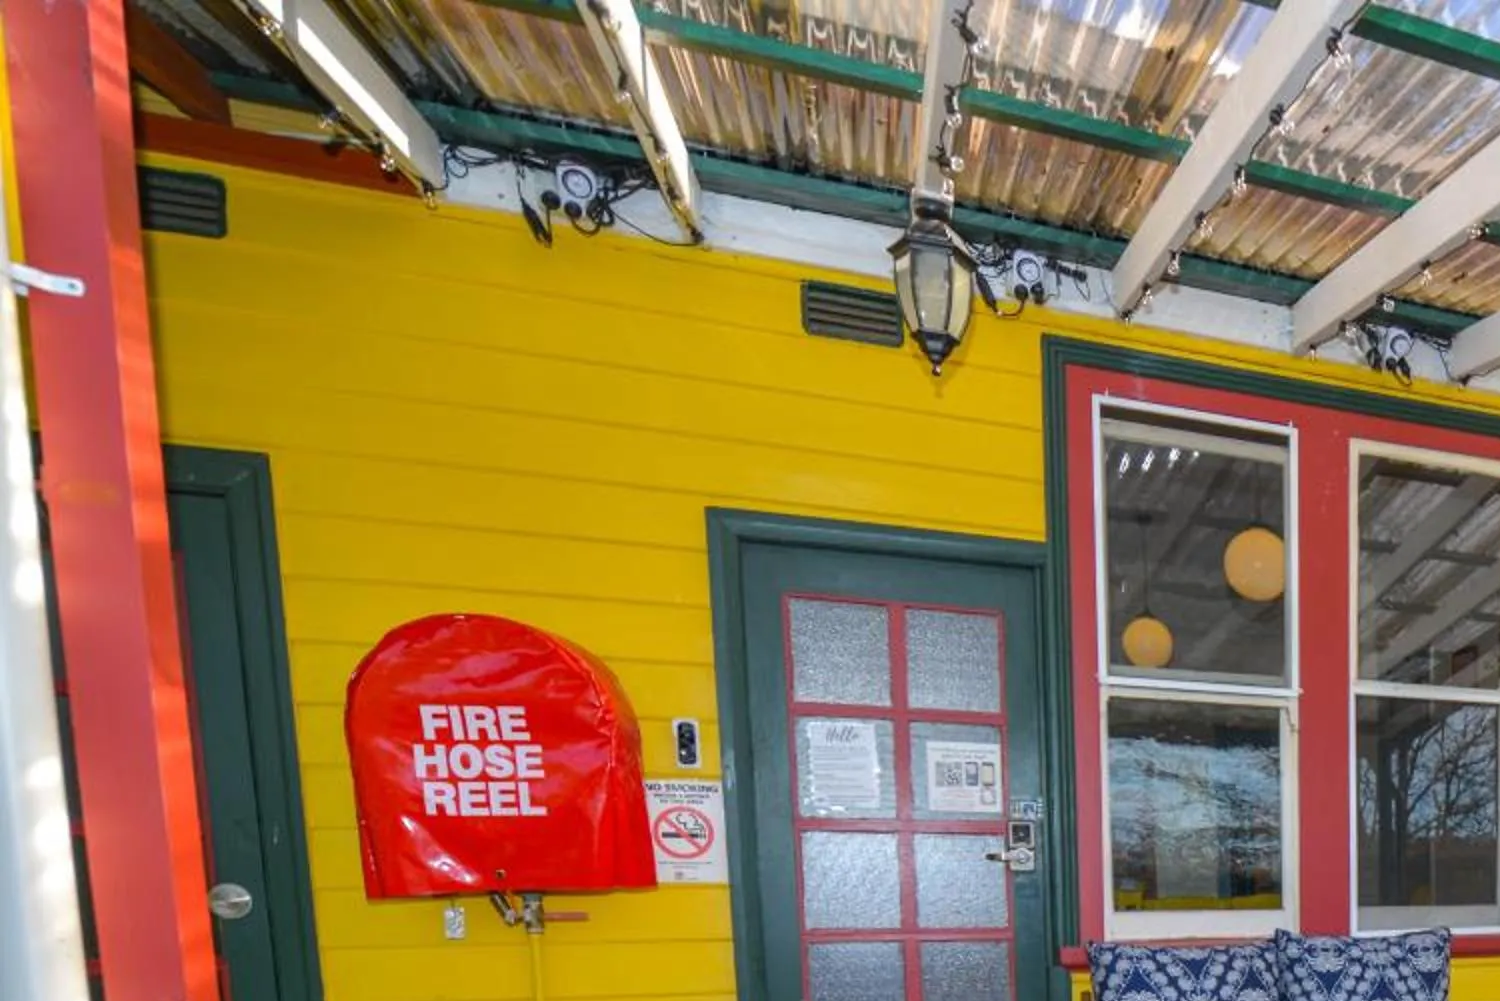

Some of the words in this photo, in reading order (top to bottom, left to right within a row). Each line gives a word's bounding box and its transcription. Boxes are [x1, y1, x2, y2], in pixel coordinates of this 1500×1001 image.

[419, 704, 531, 741] FIRE
[412, 743, 545, 779] HOSE
[422, 781, 548, 817] REEL
[645, 783, 662, 791] NO
[665, 783, 719, 793] SMOKING
